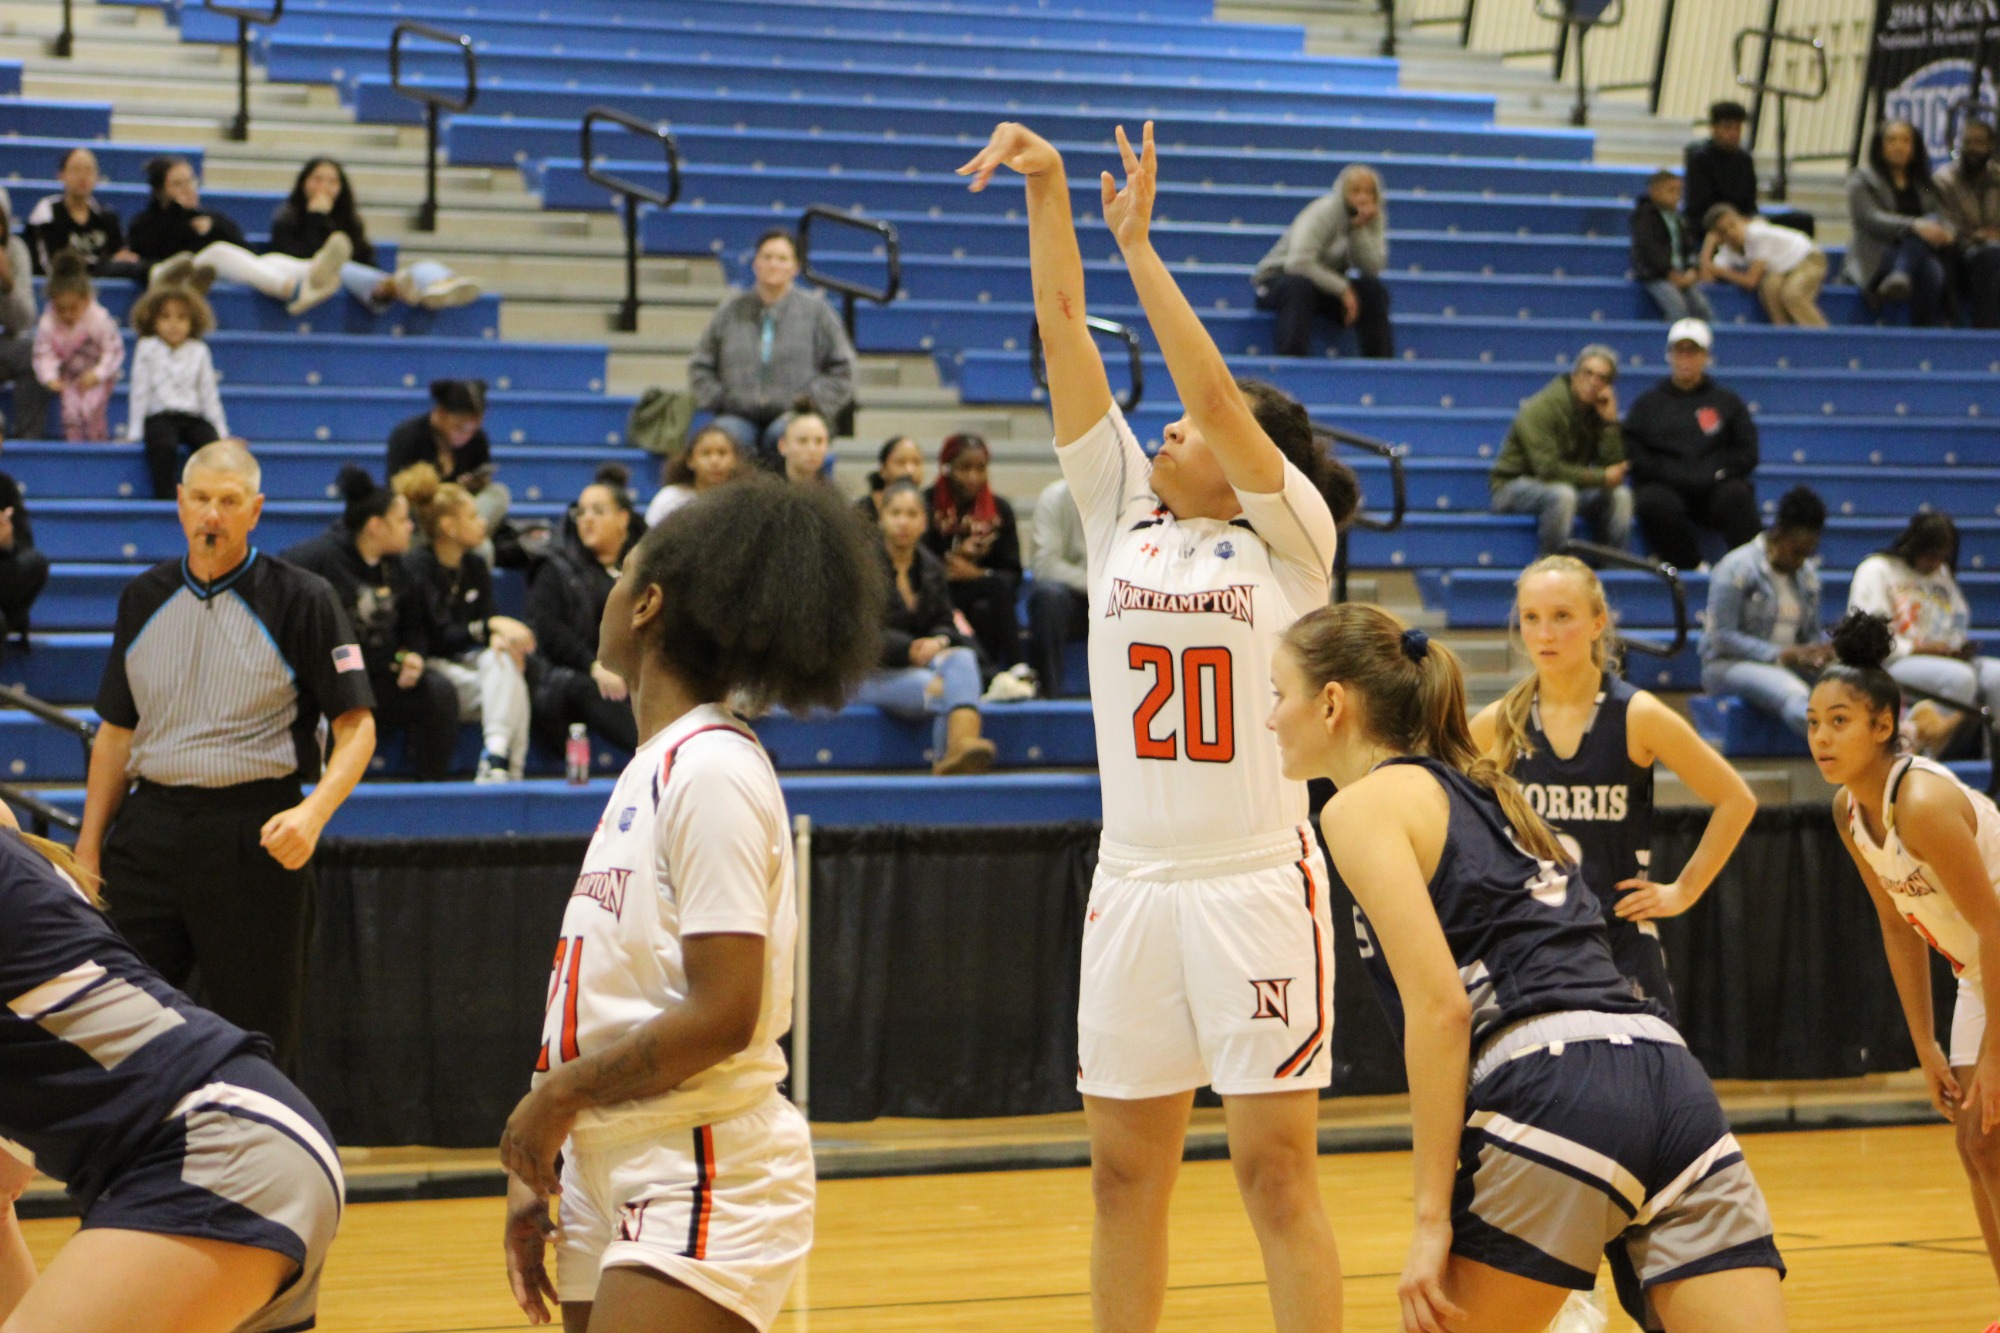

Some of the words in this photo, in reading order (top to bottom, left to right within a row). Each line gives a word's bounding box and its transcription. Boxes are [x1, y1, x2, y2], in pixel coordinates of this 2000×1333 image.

[1105, 577, 1254, 630] NORTHAMPTON
[1128, 642, 1235, 763] 20
[1518, 783, 1628, 821] ORRIS
[1248, 978, 1292, 1028] N
